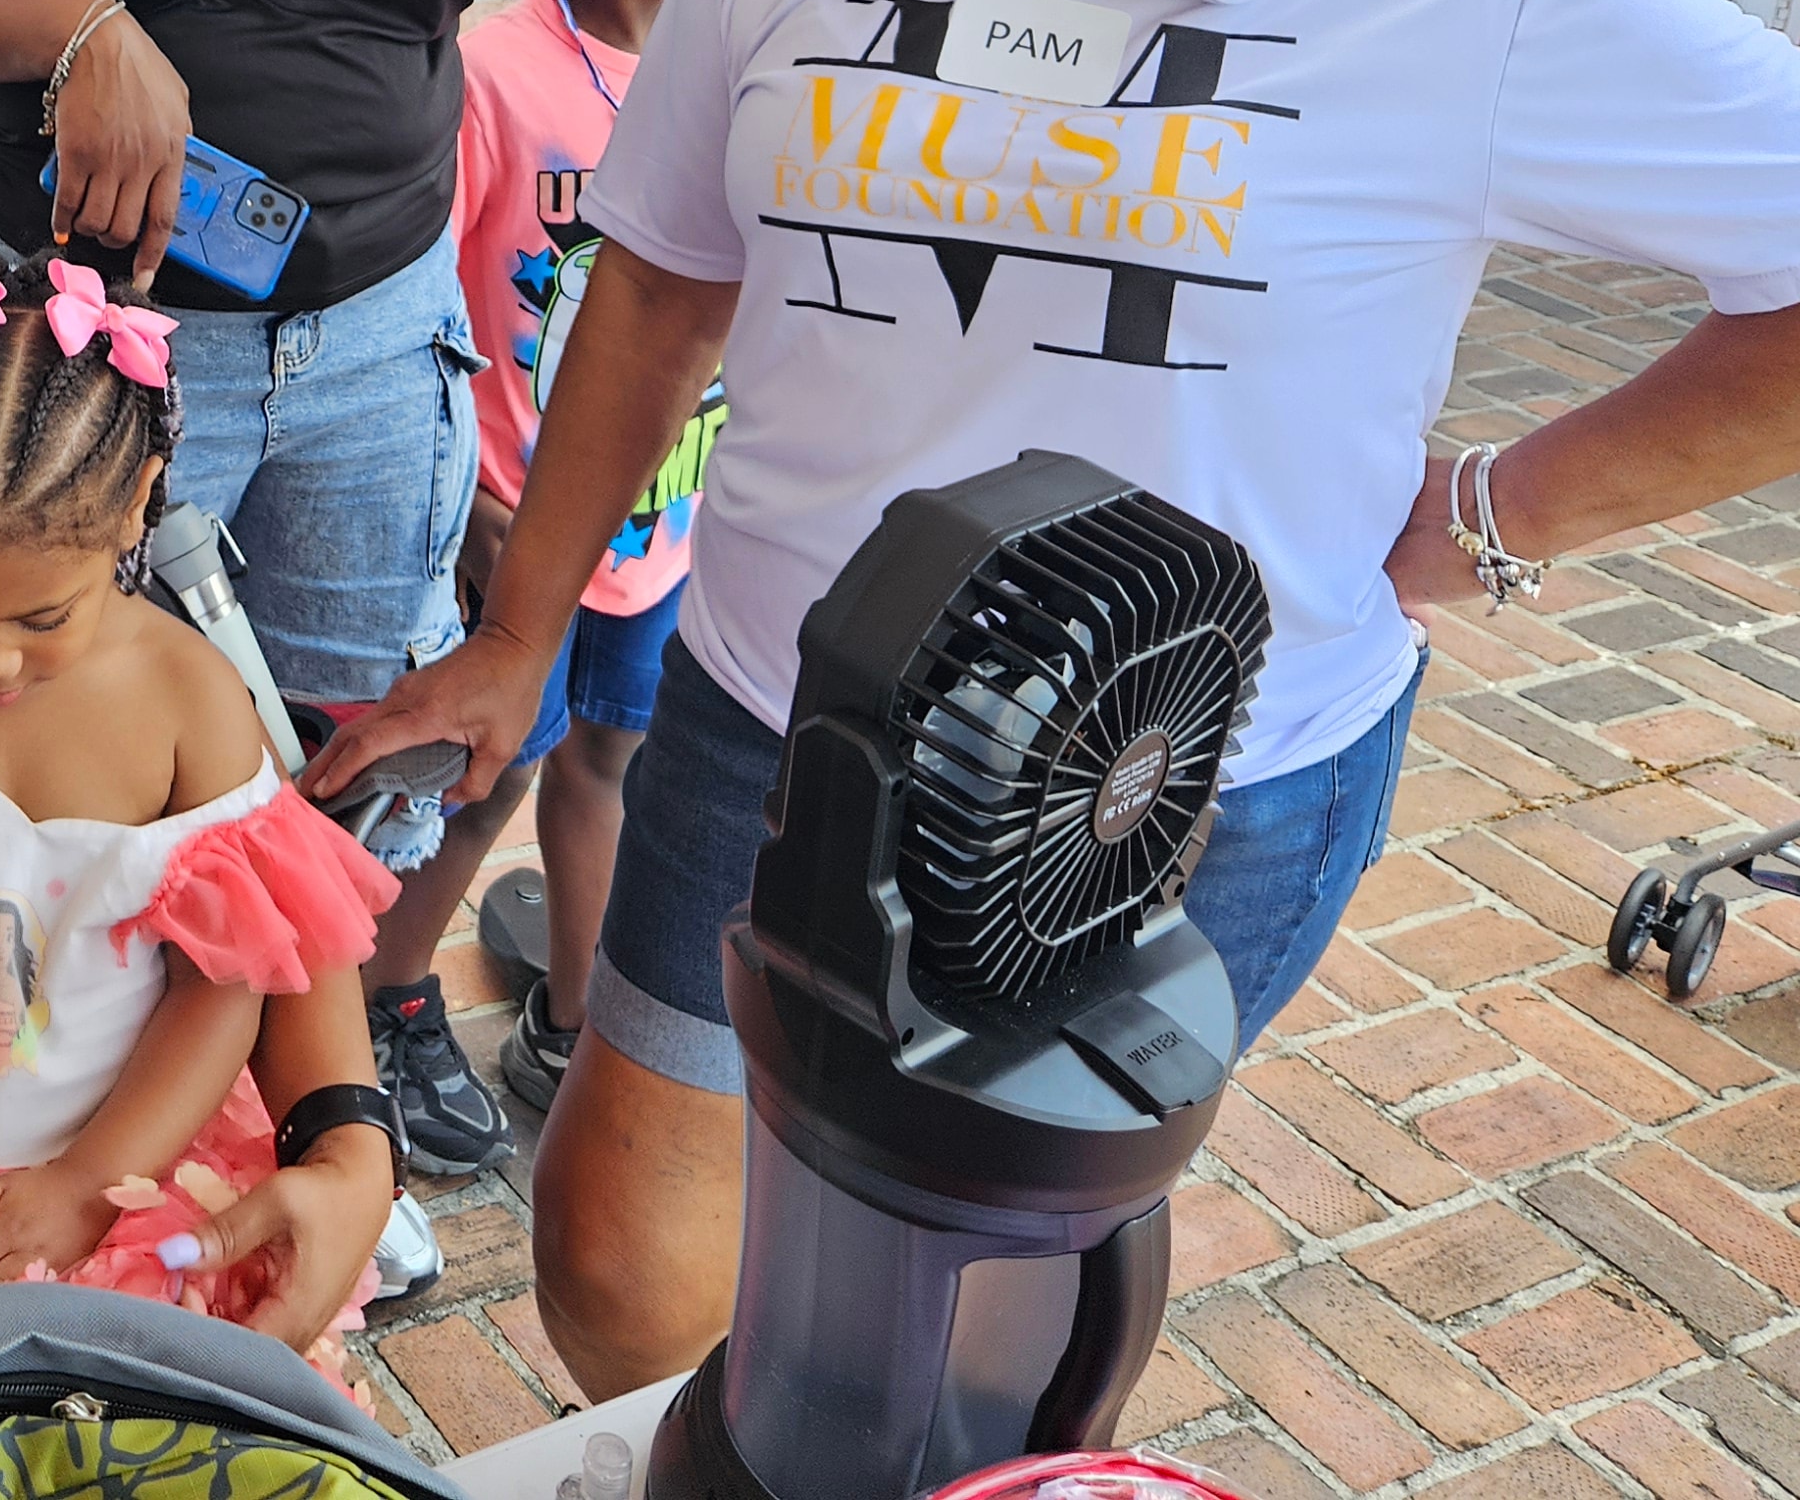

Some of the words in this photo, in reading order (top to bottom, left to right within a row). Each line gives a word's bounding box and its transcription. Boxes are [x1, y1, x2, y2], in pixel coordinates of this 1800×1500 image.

[985, 20, 1084, 67] PAM
[773, 75, 1250, 211] MUSE
[772, 160, 1243, 258] FOUNDATION
[1126, 1031, 1183, 1066] WATER
